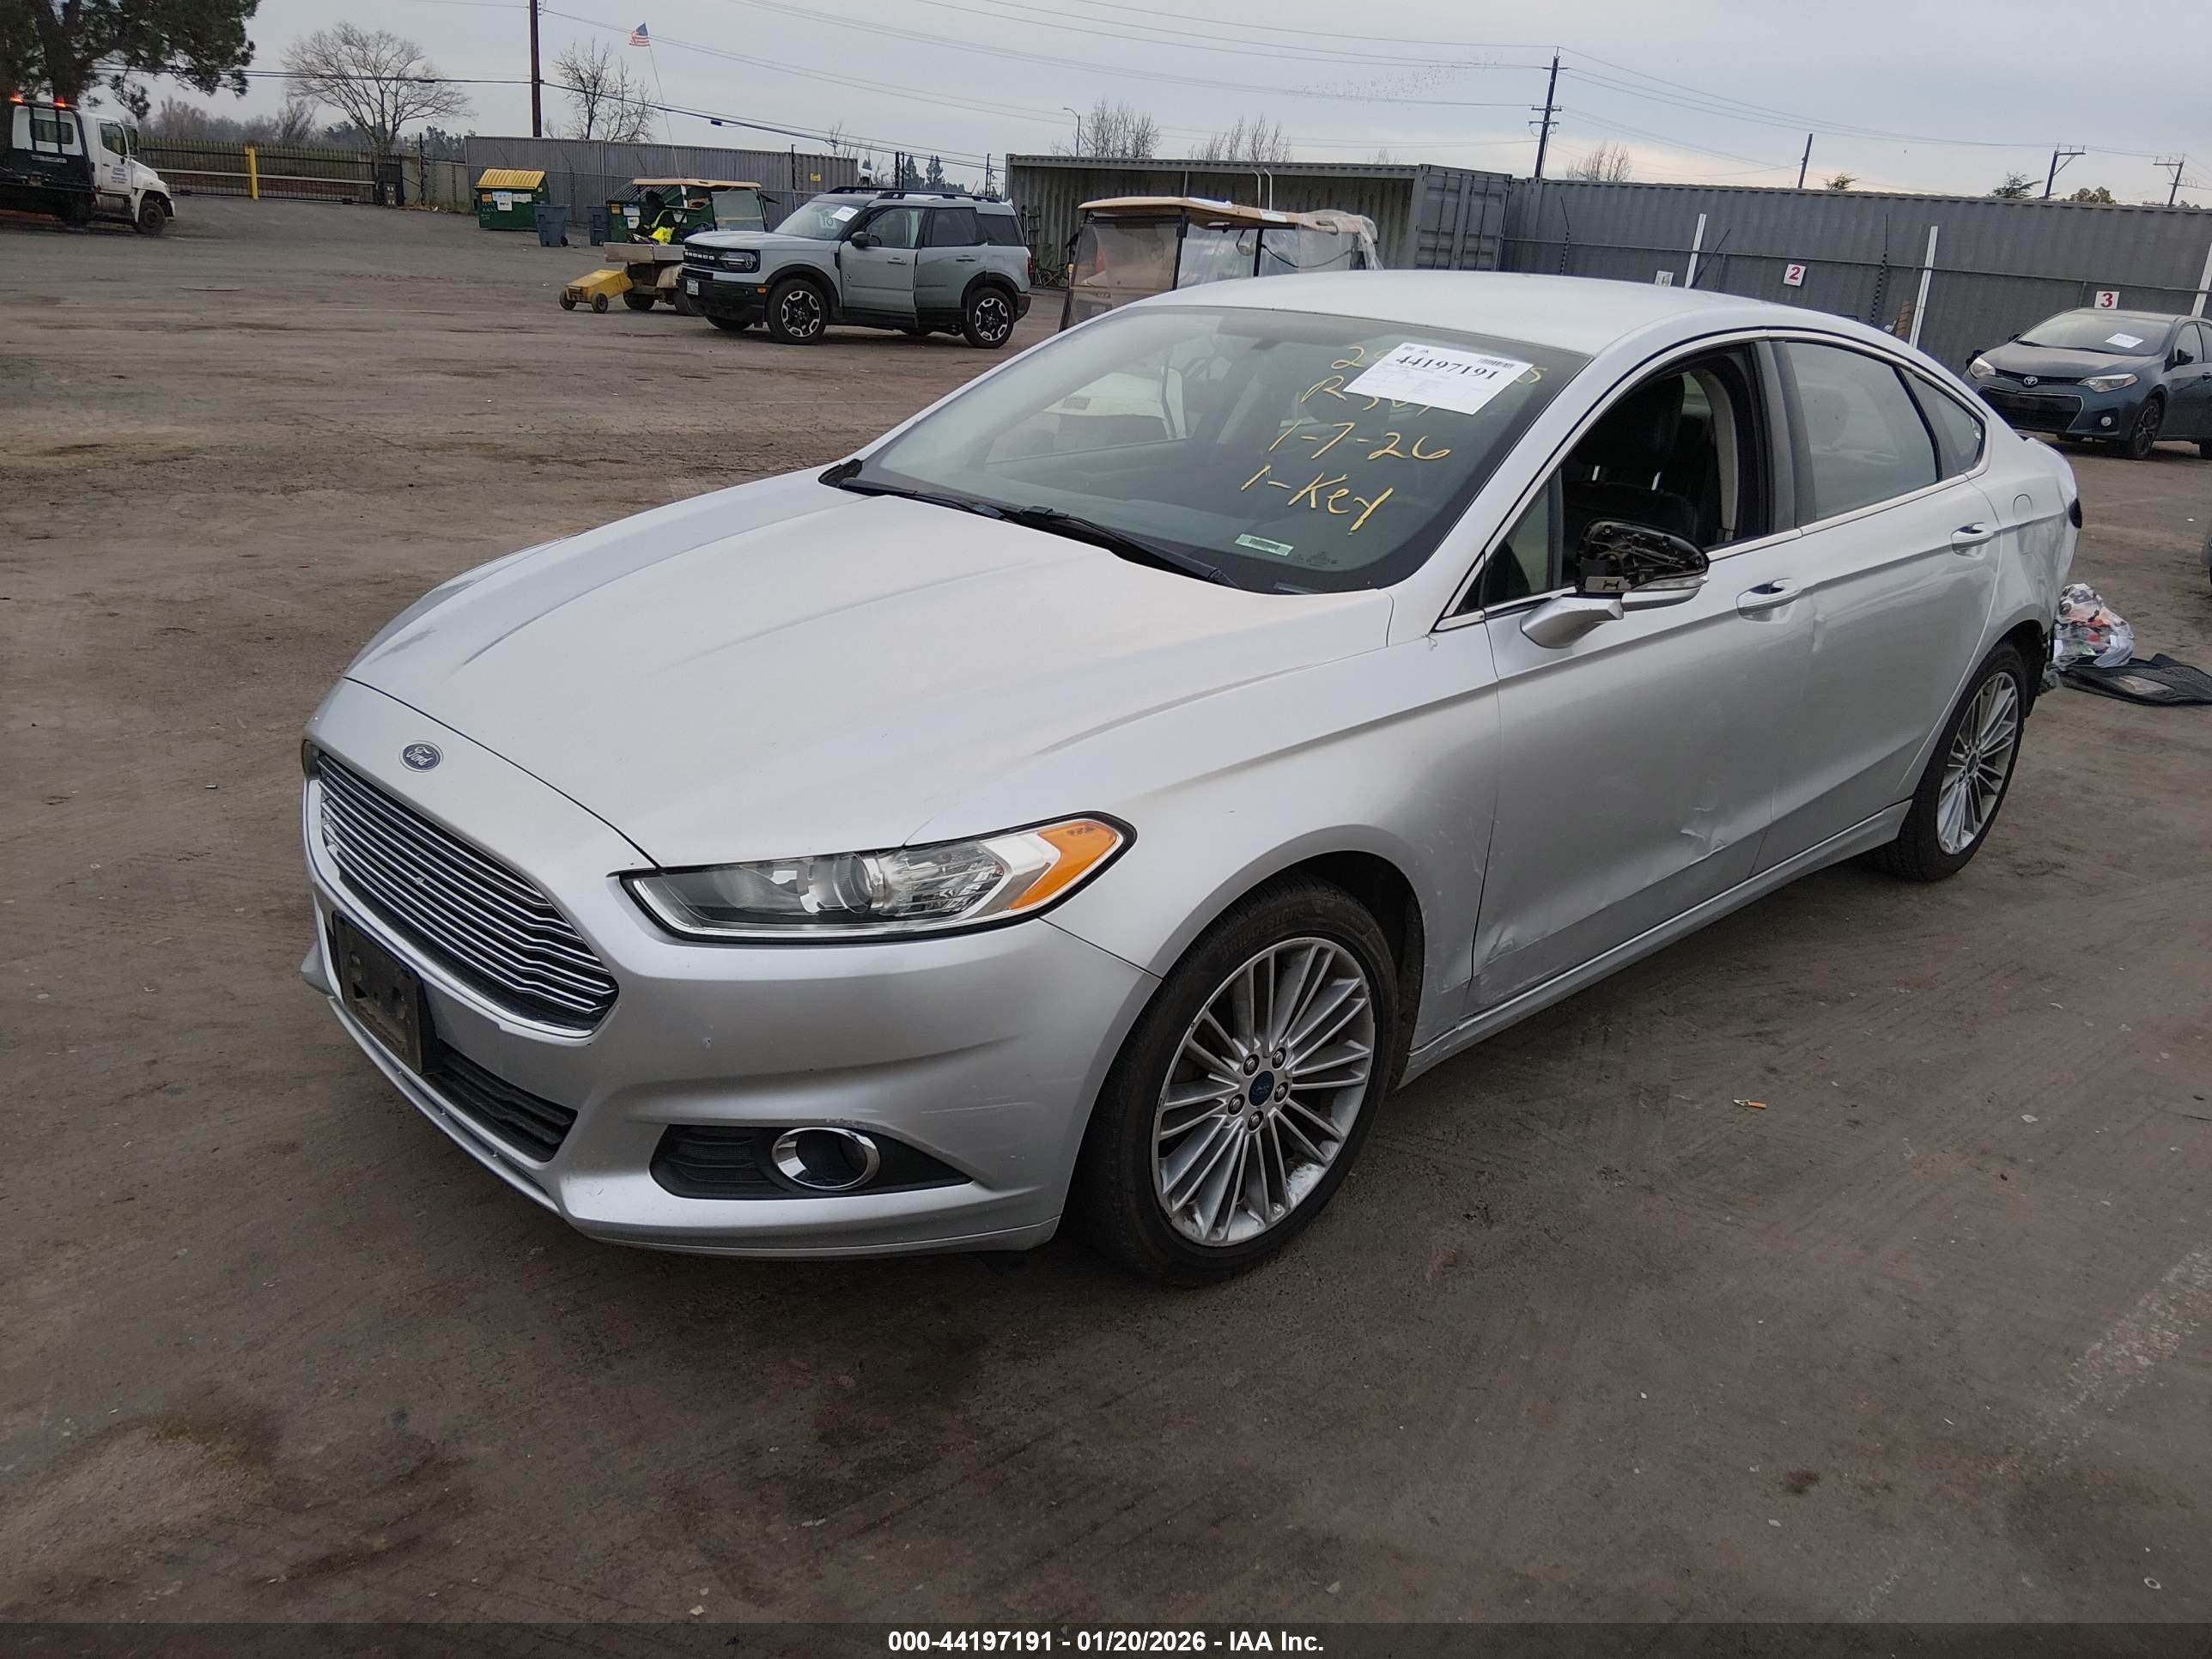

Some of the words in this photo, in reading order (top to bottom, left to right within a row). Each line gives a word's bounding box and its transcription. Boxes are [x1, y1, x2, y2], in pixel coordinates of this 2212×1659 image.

[1789, 266, 1801, 281] 2
[2100, 293, 2113, 308] 3
[1395, 355, 1499, 380] 44197191
[405, 746, 434, 766] Ford
